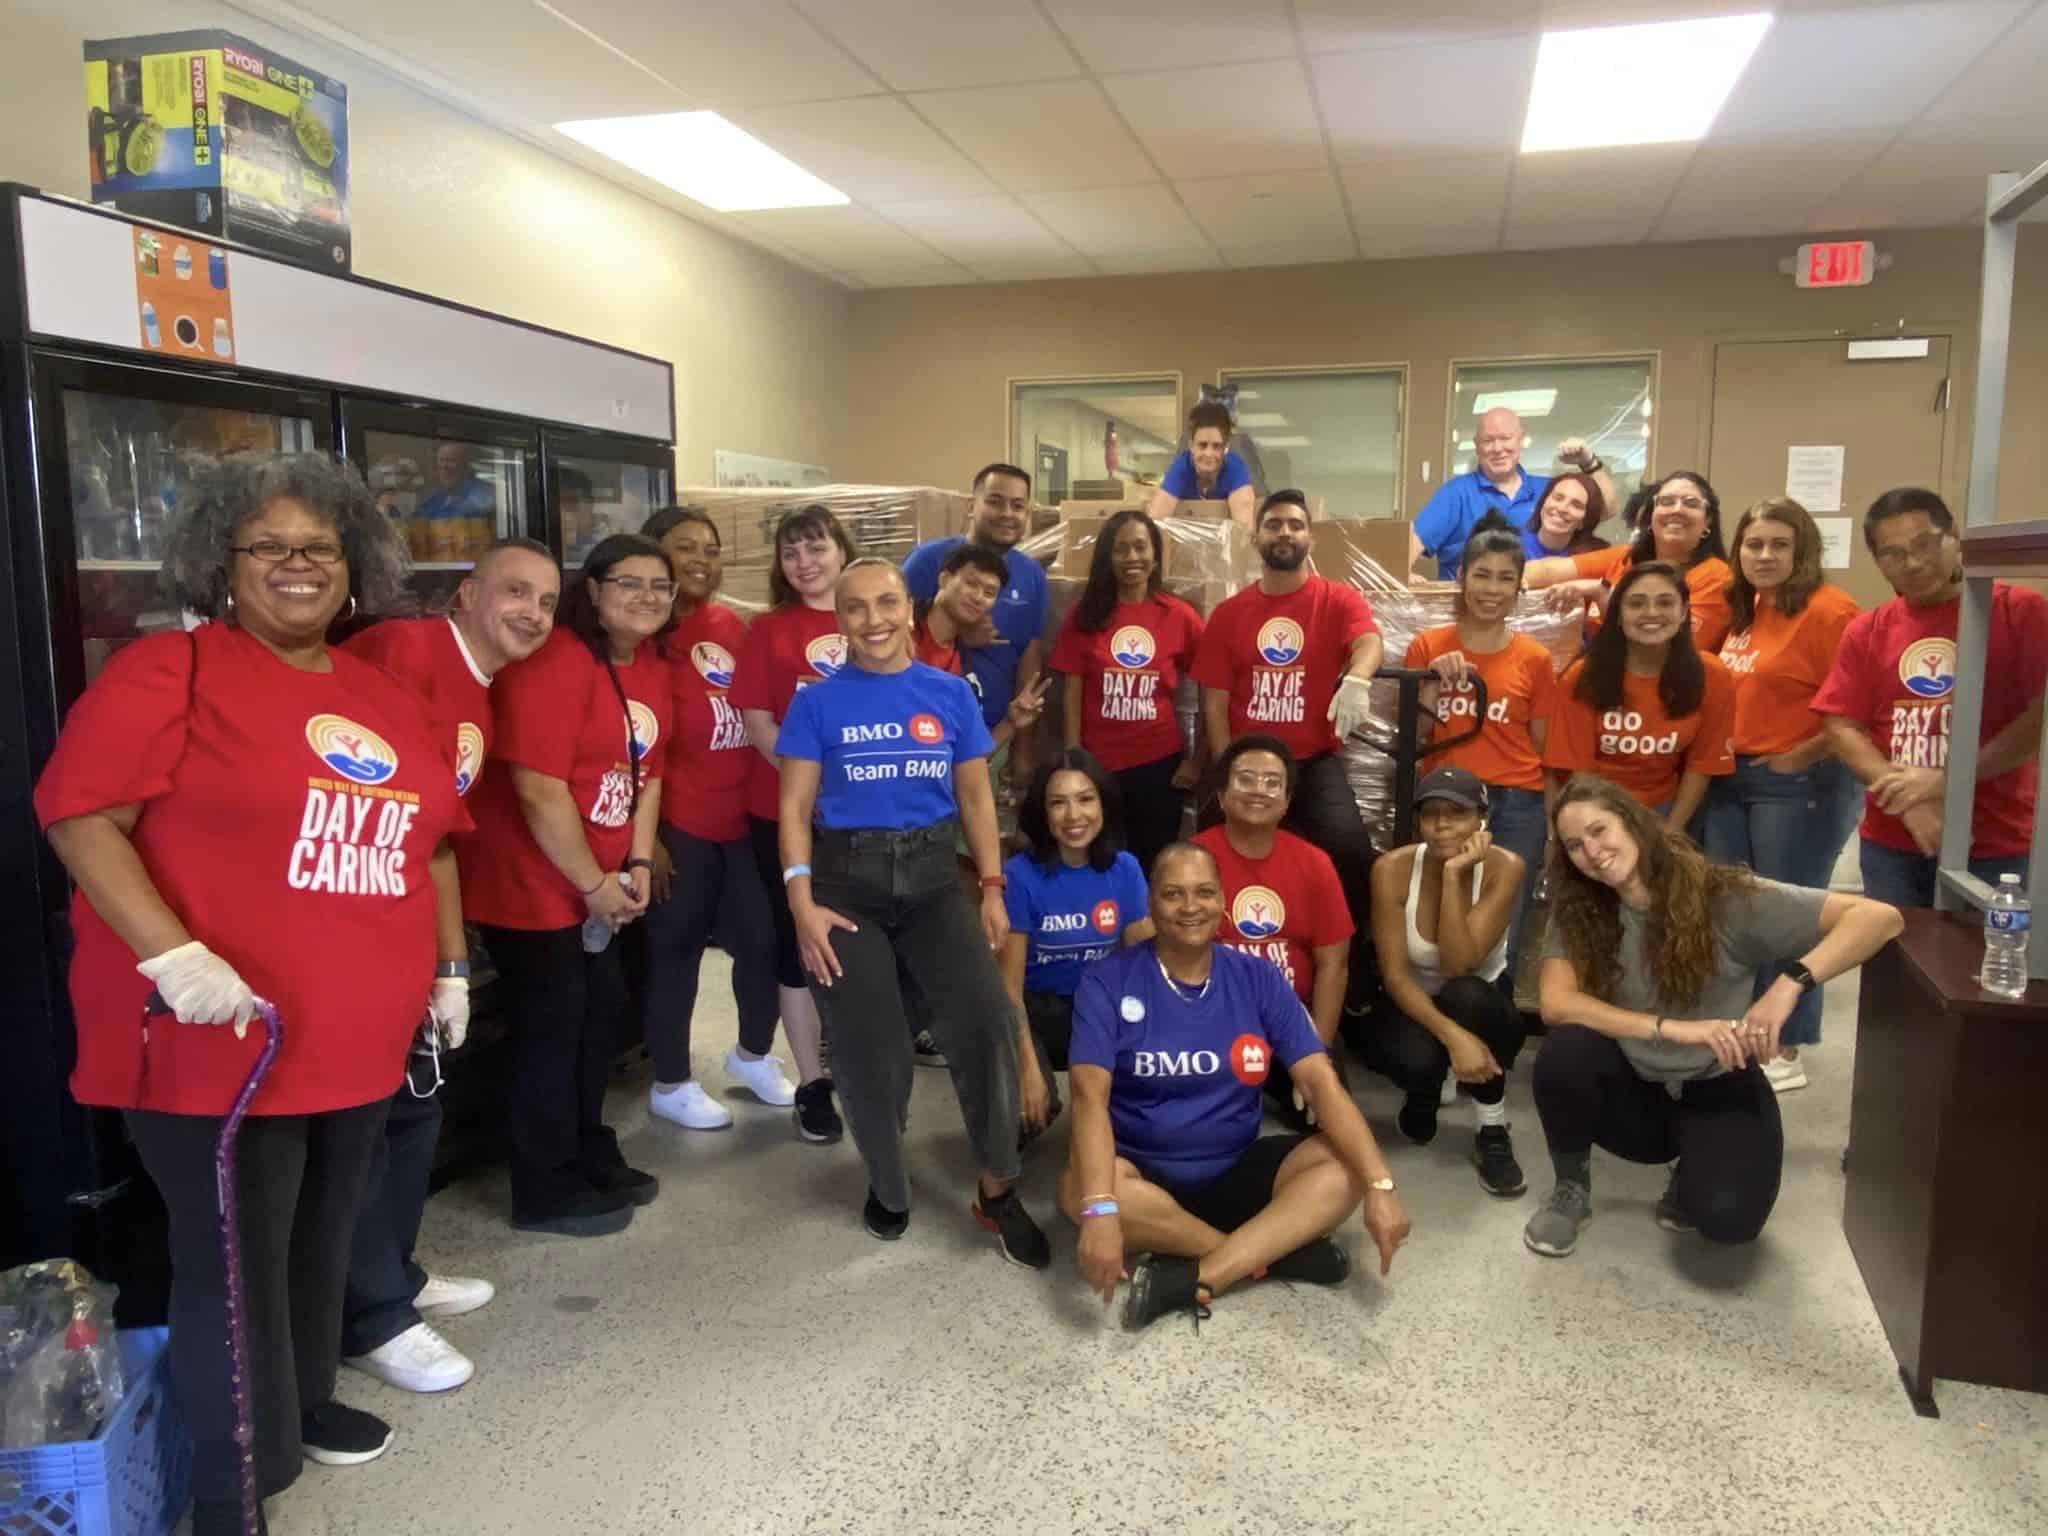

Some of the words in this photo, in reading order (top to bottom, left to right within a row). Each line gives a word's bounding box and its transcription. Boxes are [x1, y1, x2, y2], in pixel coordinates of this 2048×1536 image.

[223, 47, 265, 78] RYOBI
[192, 57, 206, 104] RYOBI
[1809, 242, 1865, 285] EXIT
[1103, 672, 1136, 697] DAY
[1139, 674, 1160, 697] OF
[1253, 671, 1283, 698] DAY
[1102, 696, 1157, 721] CARING
[1247, 696, 1305, 723] CARING
[842, 722, 903, 744] BMO
[843, 763, 898, 781] Team
[905, 760, 948, 779] BMO
[301, 788, 374, 845] DAY
[374, 800, 421, 850] OF
[288, 838, 408, 897] CARING
[1040, 912, 1087, 932] BMO
[1133, 1049, 1221, 1078] BMO
